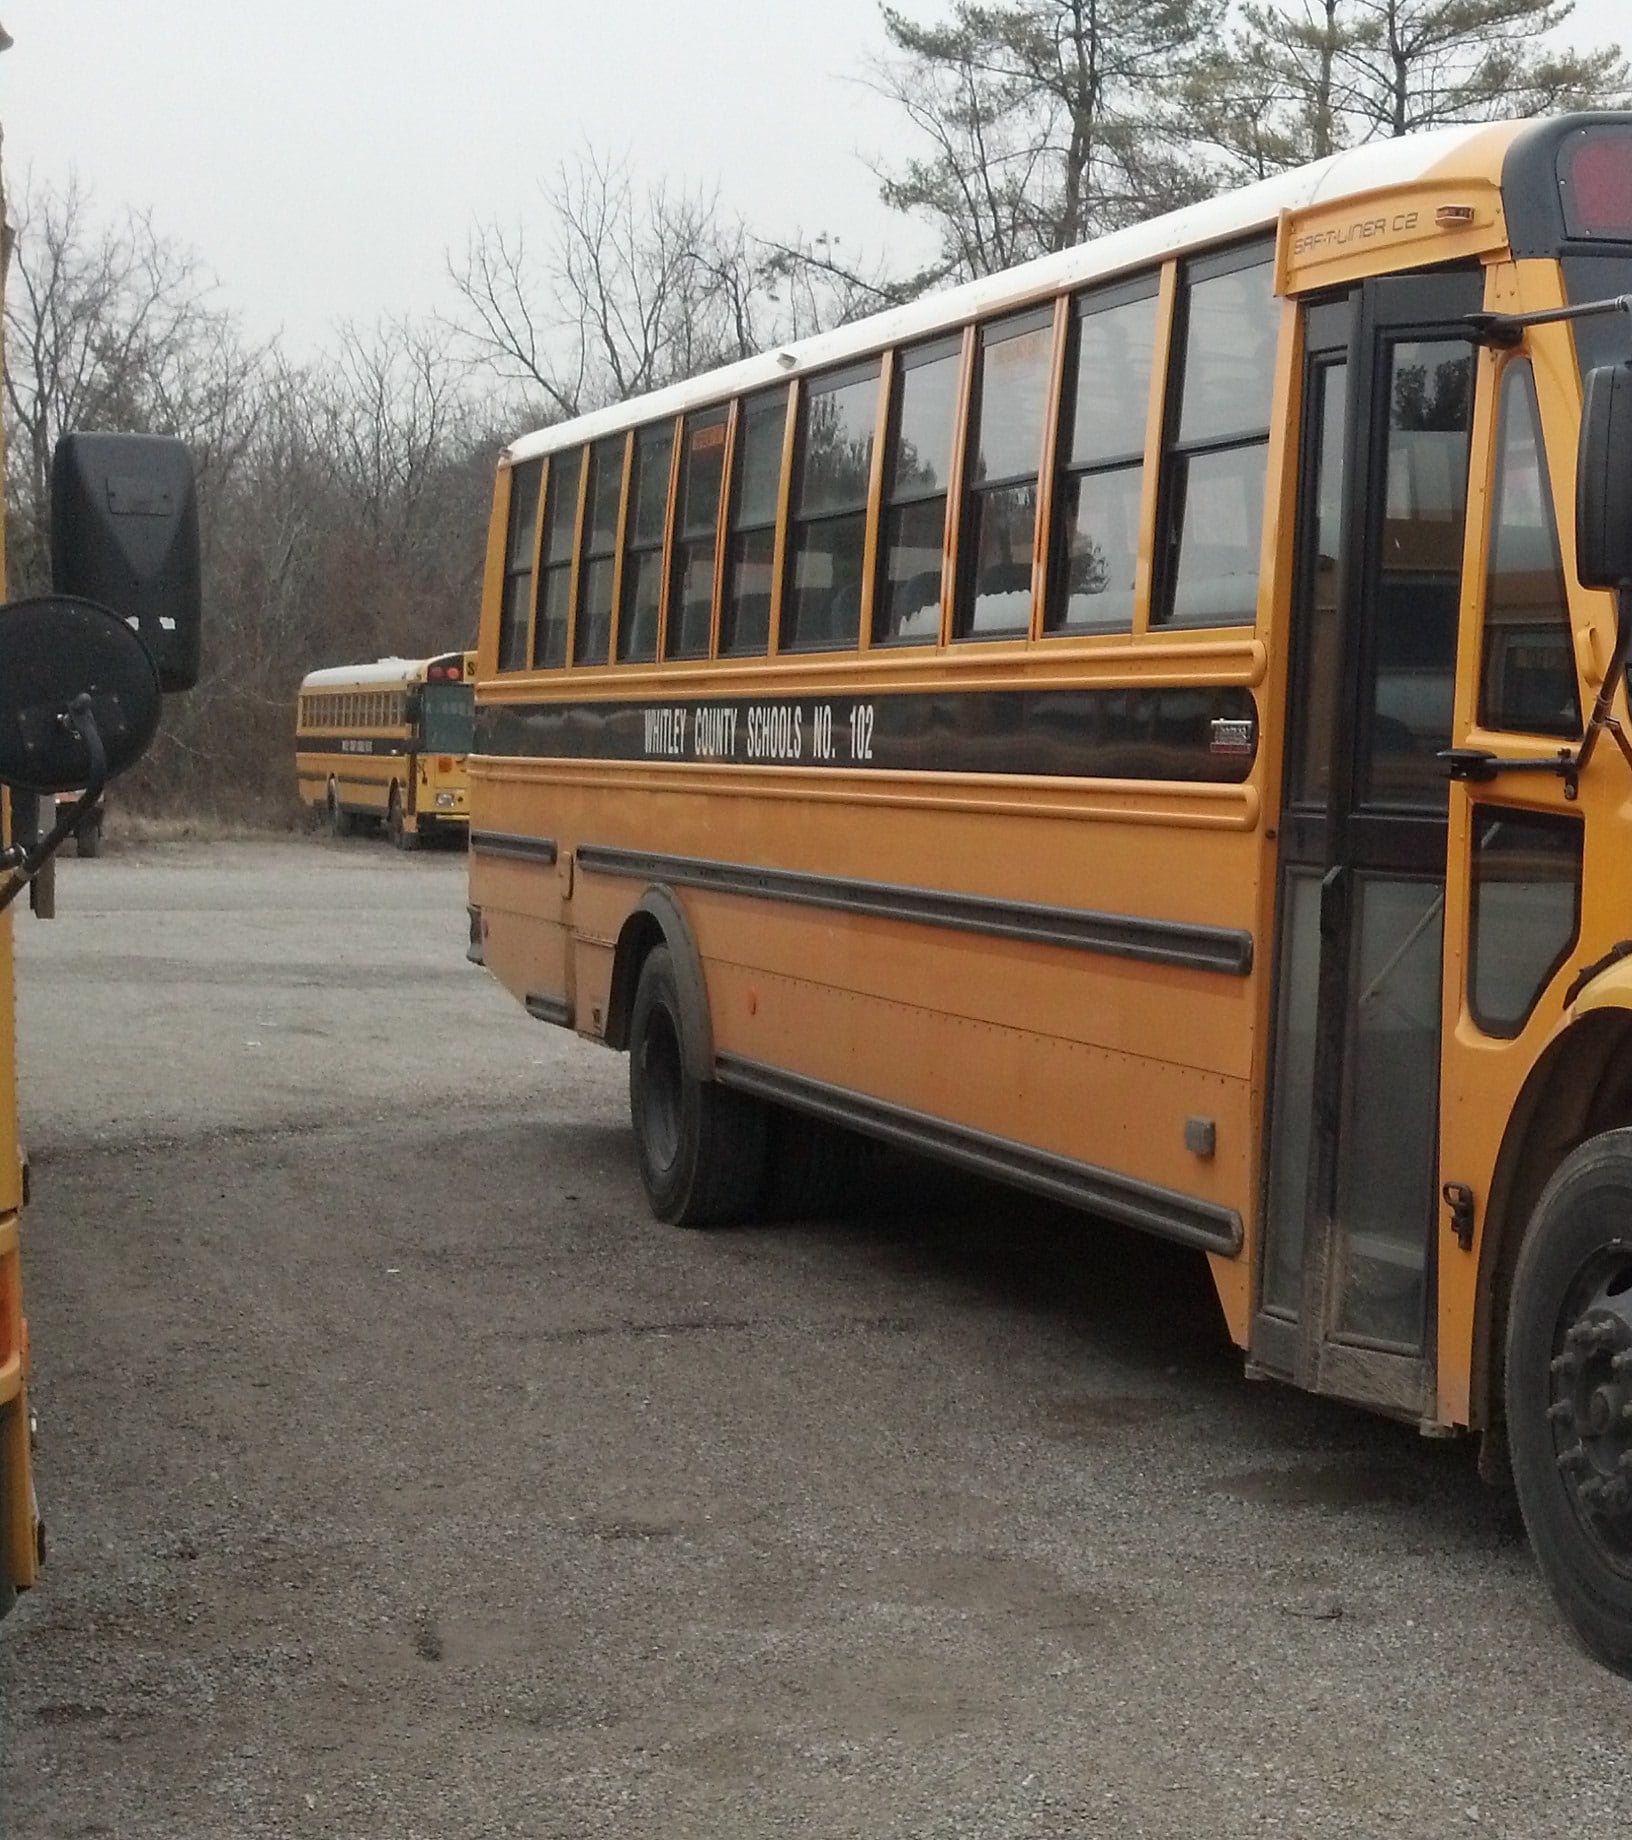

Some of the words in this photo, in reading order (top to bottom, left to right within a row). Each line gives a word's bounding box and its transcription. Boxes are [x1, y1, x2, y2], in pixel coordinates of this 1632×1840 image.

[1392, 212, 1419, 231] C2
[644, 708, 687, 754] WHITLEY
[694, 707, 738, 757] COUNTY
[747, 705, 802, 759] SCHOOLS
[813, 704, 836, 760] NO.
[849, 704, 874, 760] 102
